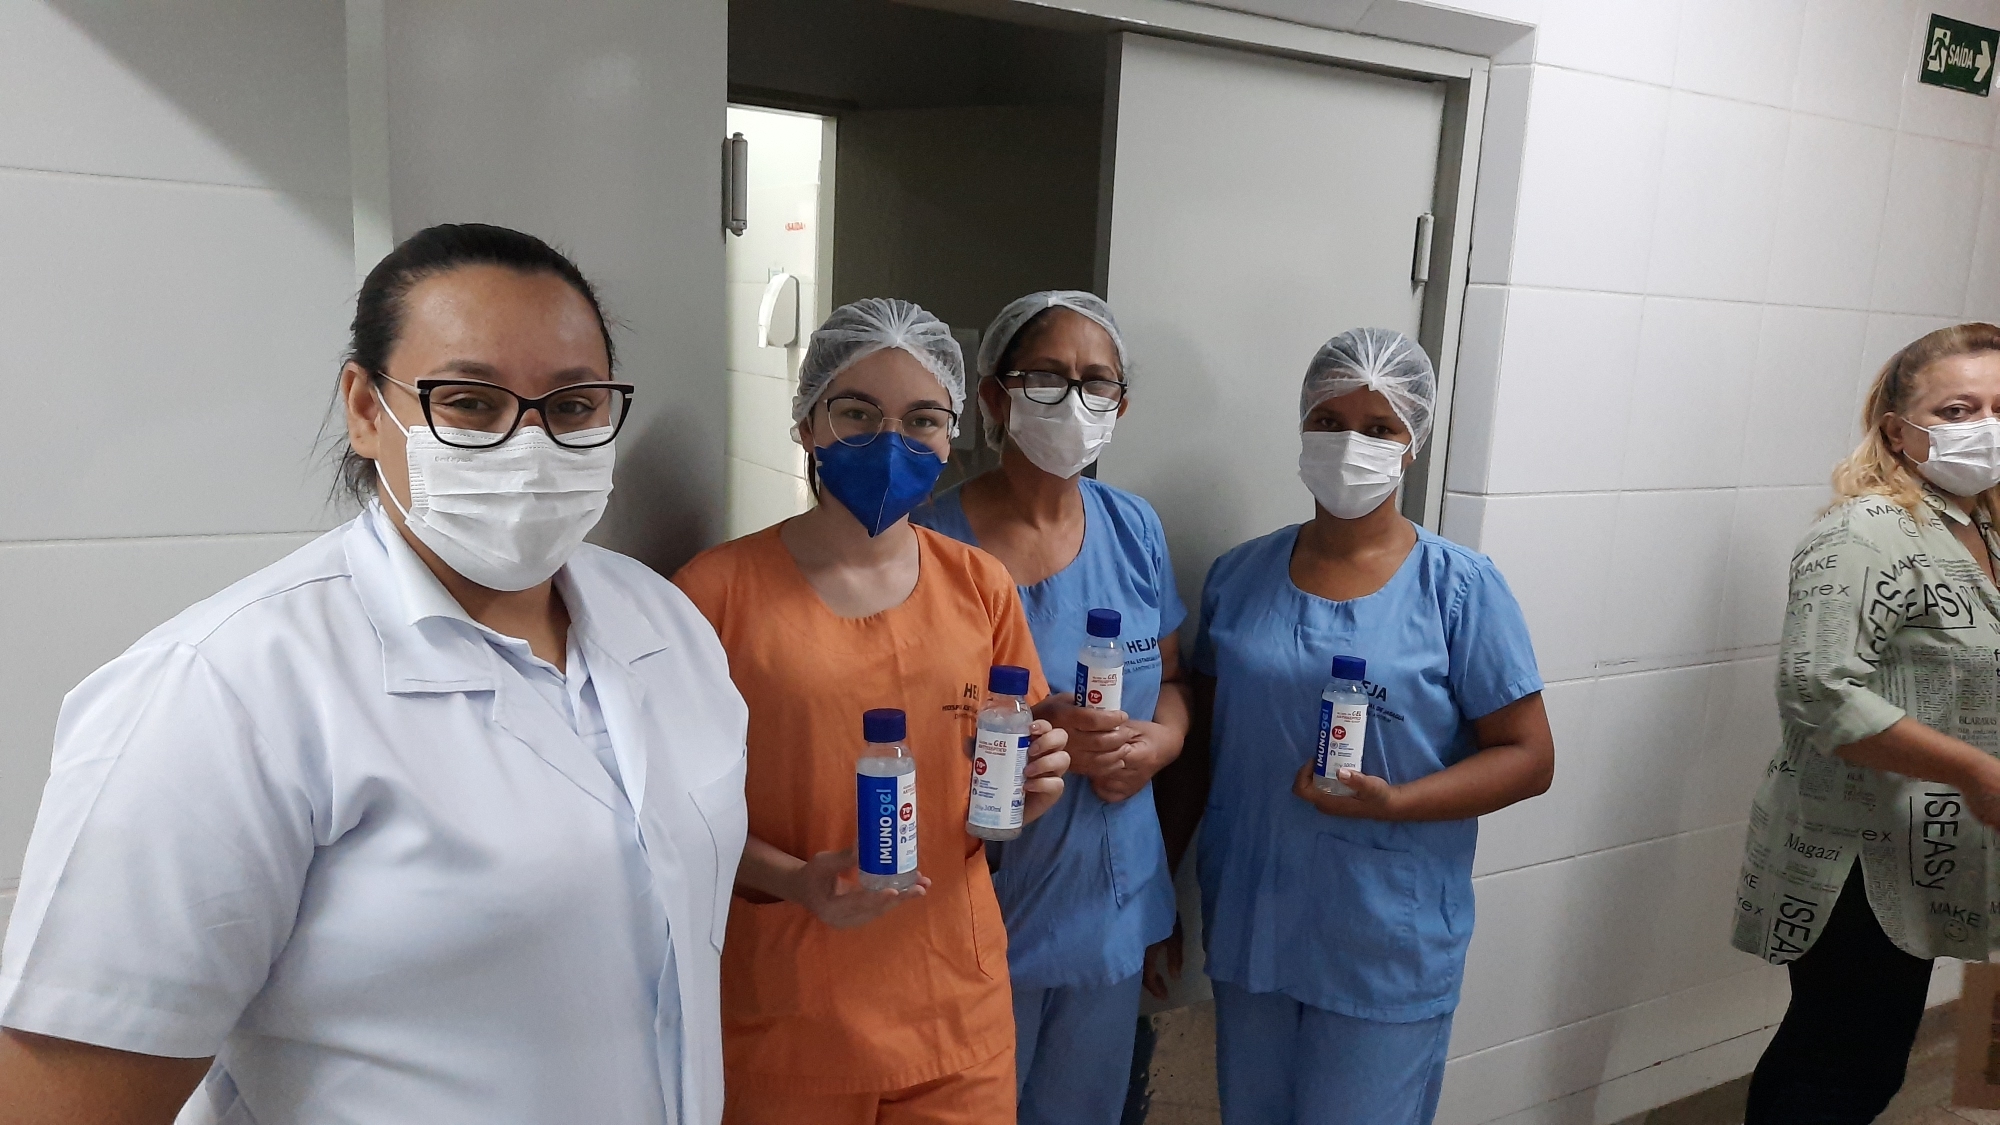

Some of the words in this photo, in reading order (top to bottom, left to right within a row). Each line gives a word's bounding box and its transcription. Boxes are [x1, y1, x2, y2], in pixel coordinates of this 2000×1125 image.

[1947, 42, 1974, 69] SAÍDA
[993, 739, 1008, 748] GEL
[1784, 833, 1843, 861] Magazi
[1930, 901, 1981, 928] MAKE
